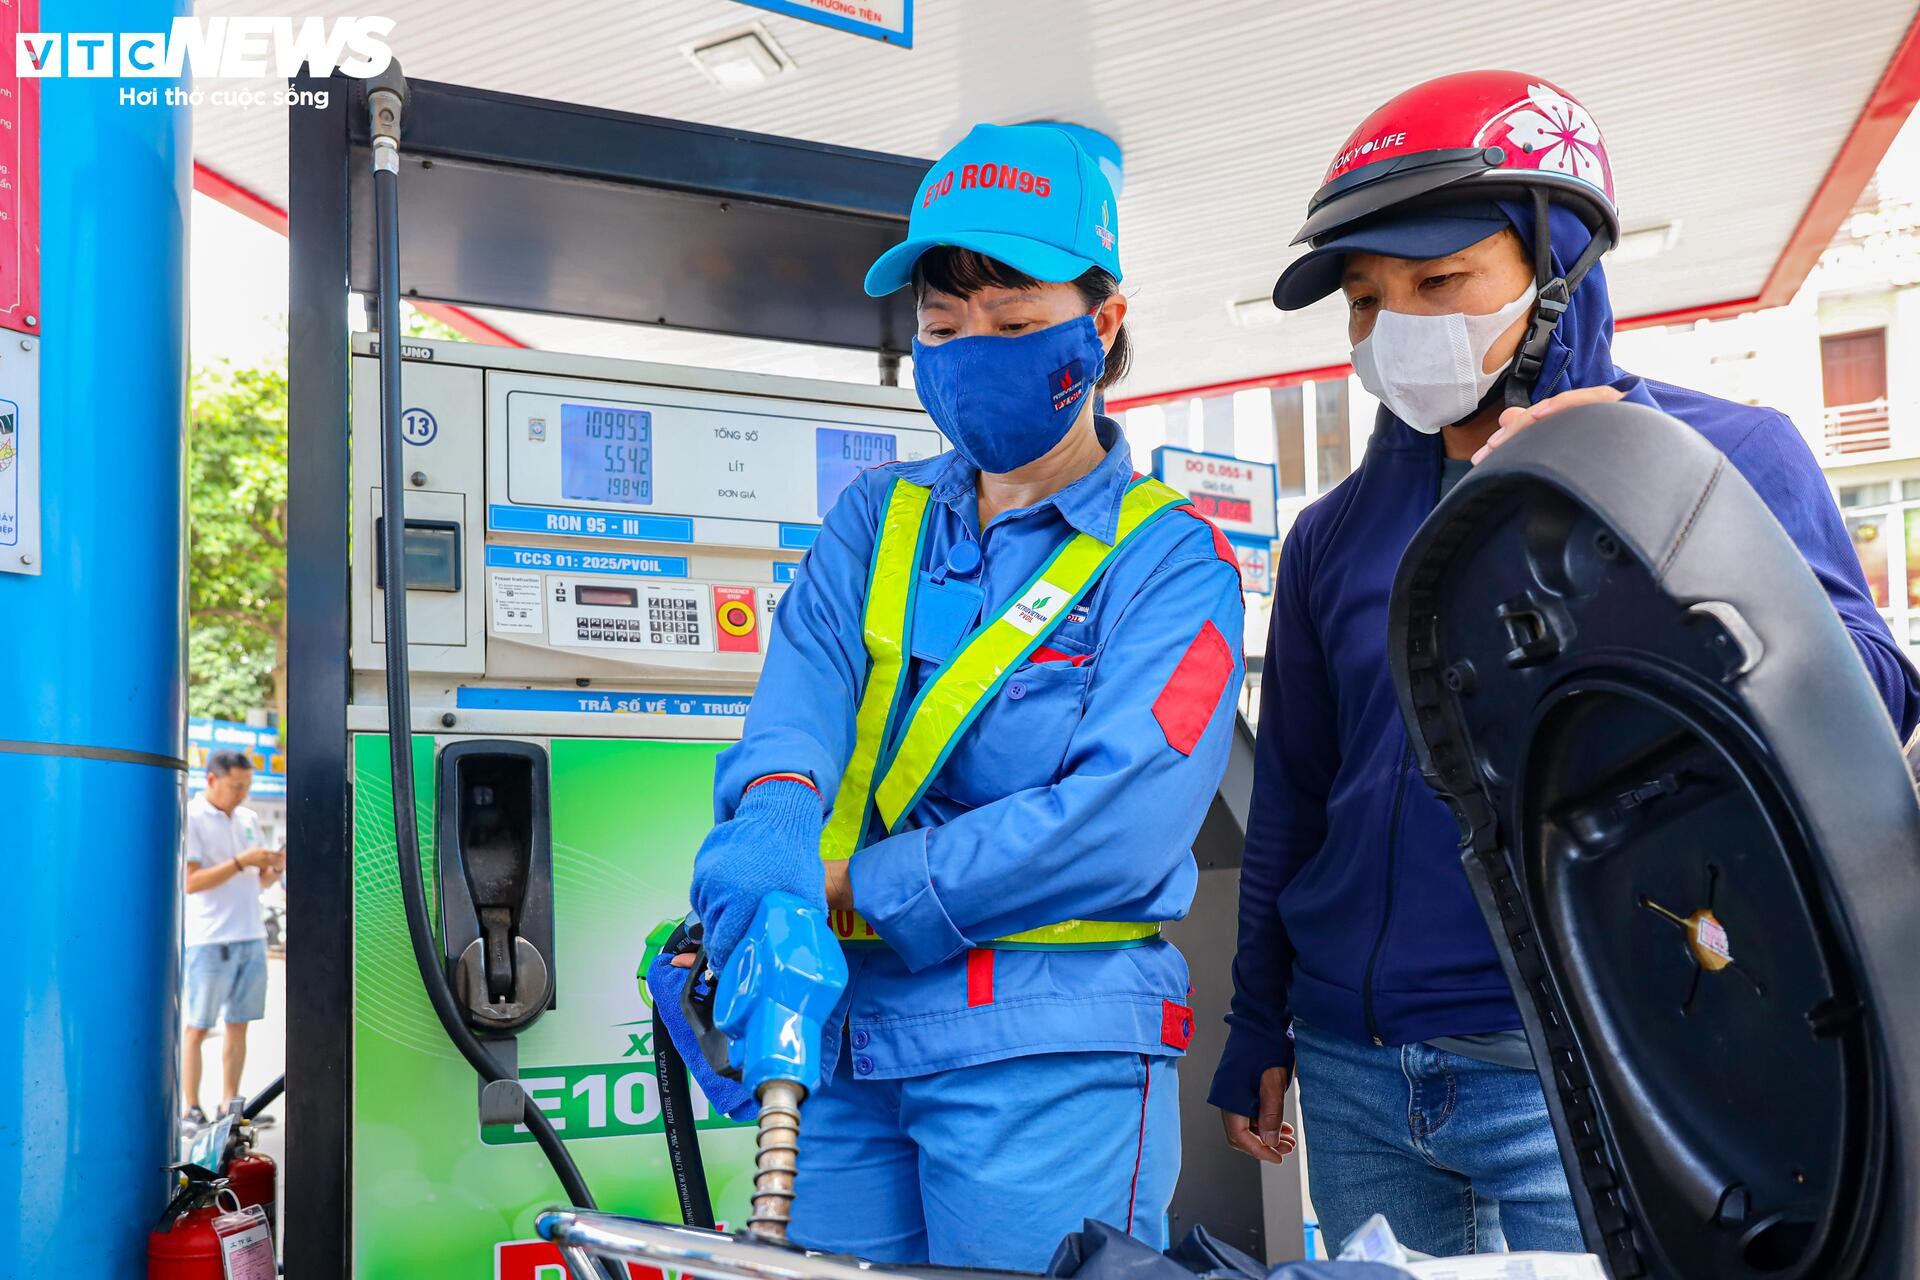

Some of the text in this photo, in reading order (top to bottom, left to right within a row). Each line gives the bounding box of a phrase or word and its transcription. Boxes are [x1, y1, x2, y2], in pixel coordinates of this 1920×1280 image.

[922, 163, 1051, 209] E10 RON95
[407, 416, 430, 437] 13
[586, 410, 649, 443] 109953
[728, 461, 745, 473] LÍT
[547, 514, 582, 530] RON
[586, 518, 606, 532] 95
[622, 520, 639, 535] III
[514, 551, 662, 573] TCCS 01: 2025/PVOIL
[579, 695, 612, 711] TRẢ
[617, 697, 641, 712] SỐ
[659, 1050, 670, 1093] FUTURA
